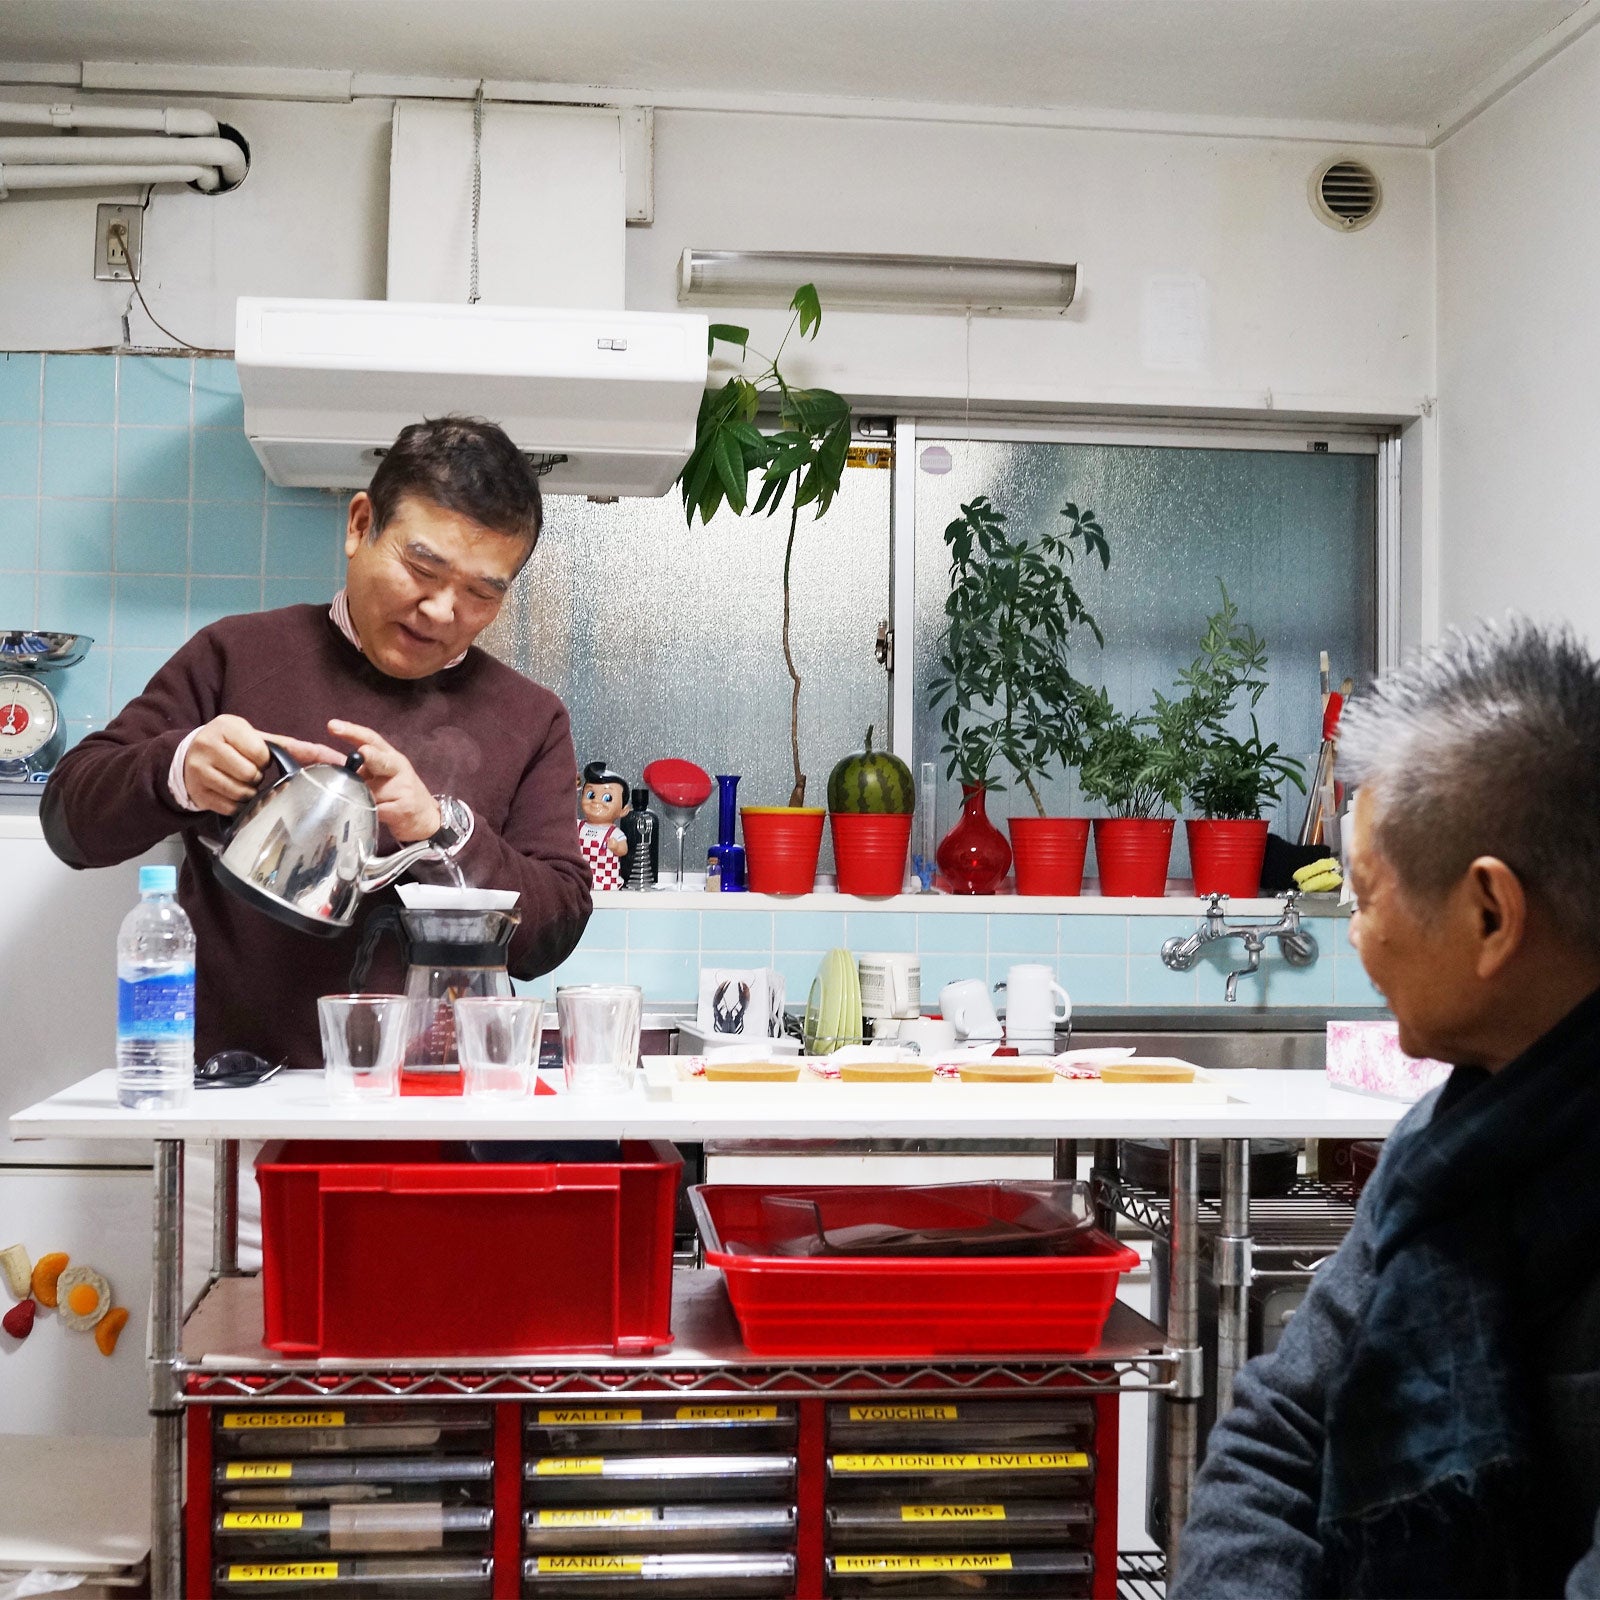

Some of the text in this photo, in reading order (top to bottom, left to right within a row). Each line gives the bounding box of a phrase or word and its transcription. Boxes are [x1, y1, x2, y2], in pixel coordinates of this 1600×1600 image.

[235, 1413, 333, 1427] SCISSORS
[856, 1407, 946, 1420] VOUCHER
[845, 1454, 1075, 1467] STATIONERY ENVELOPE
[913, 1506, 994, 1518] STAMPS
[236, 1512, 290, 1526] CARD
[549, 1557, 632, 1569] MANUAL
[932, 1555, 1000, 1568] STAMP
[242, 1565, 326, 1578] STICKER
